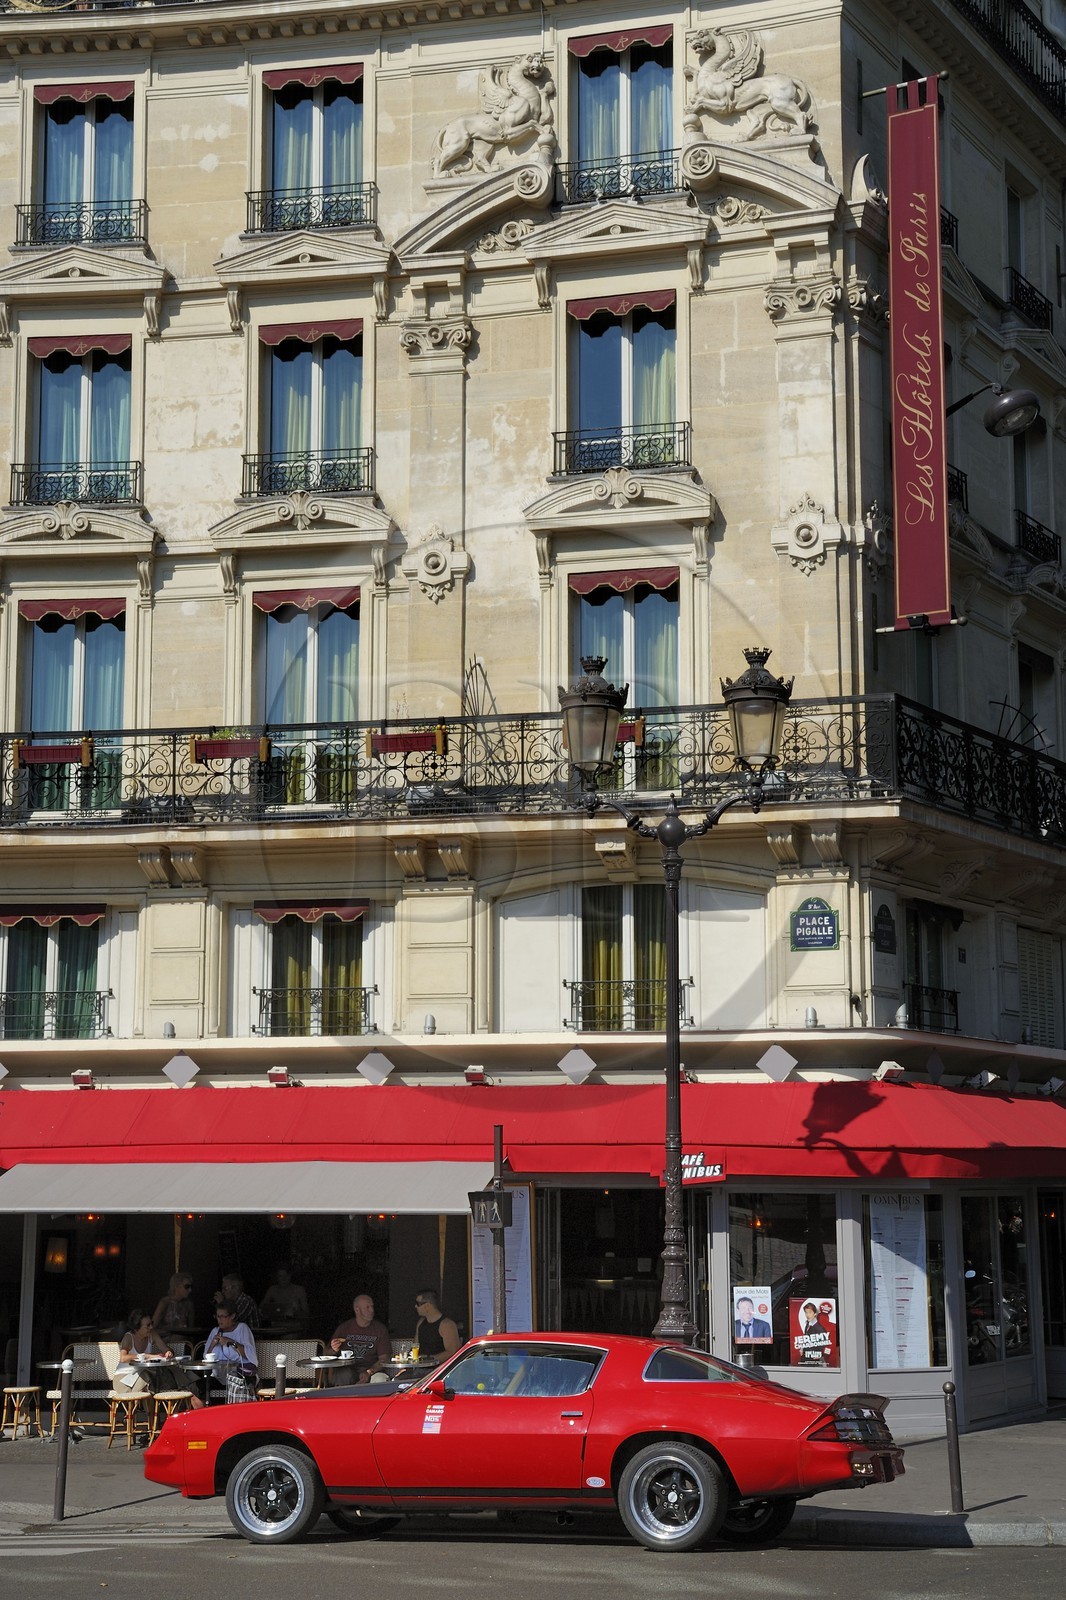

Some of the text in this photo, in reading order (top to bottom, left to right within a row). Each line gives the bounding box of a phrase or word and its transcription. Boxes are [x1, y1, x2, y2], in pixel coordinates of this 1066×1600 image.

[895, 192, 935, 525] Les Hôtels de Paris
[799, 916, 830, 926] PLACE
[796, 926, 834, 936] PIGALLE
[681, 1152, 704, 1166] AFÉ
[794, 1332, 830, 1345] JEREMY
